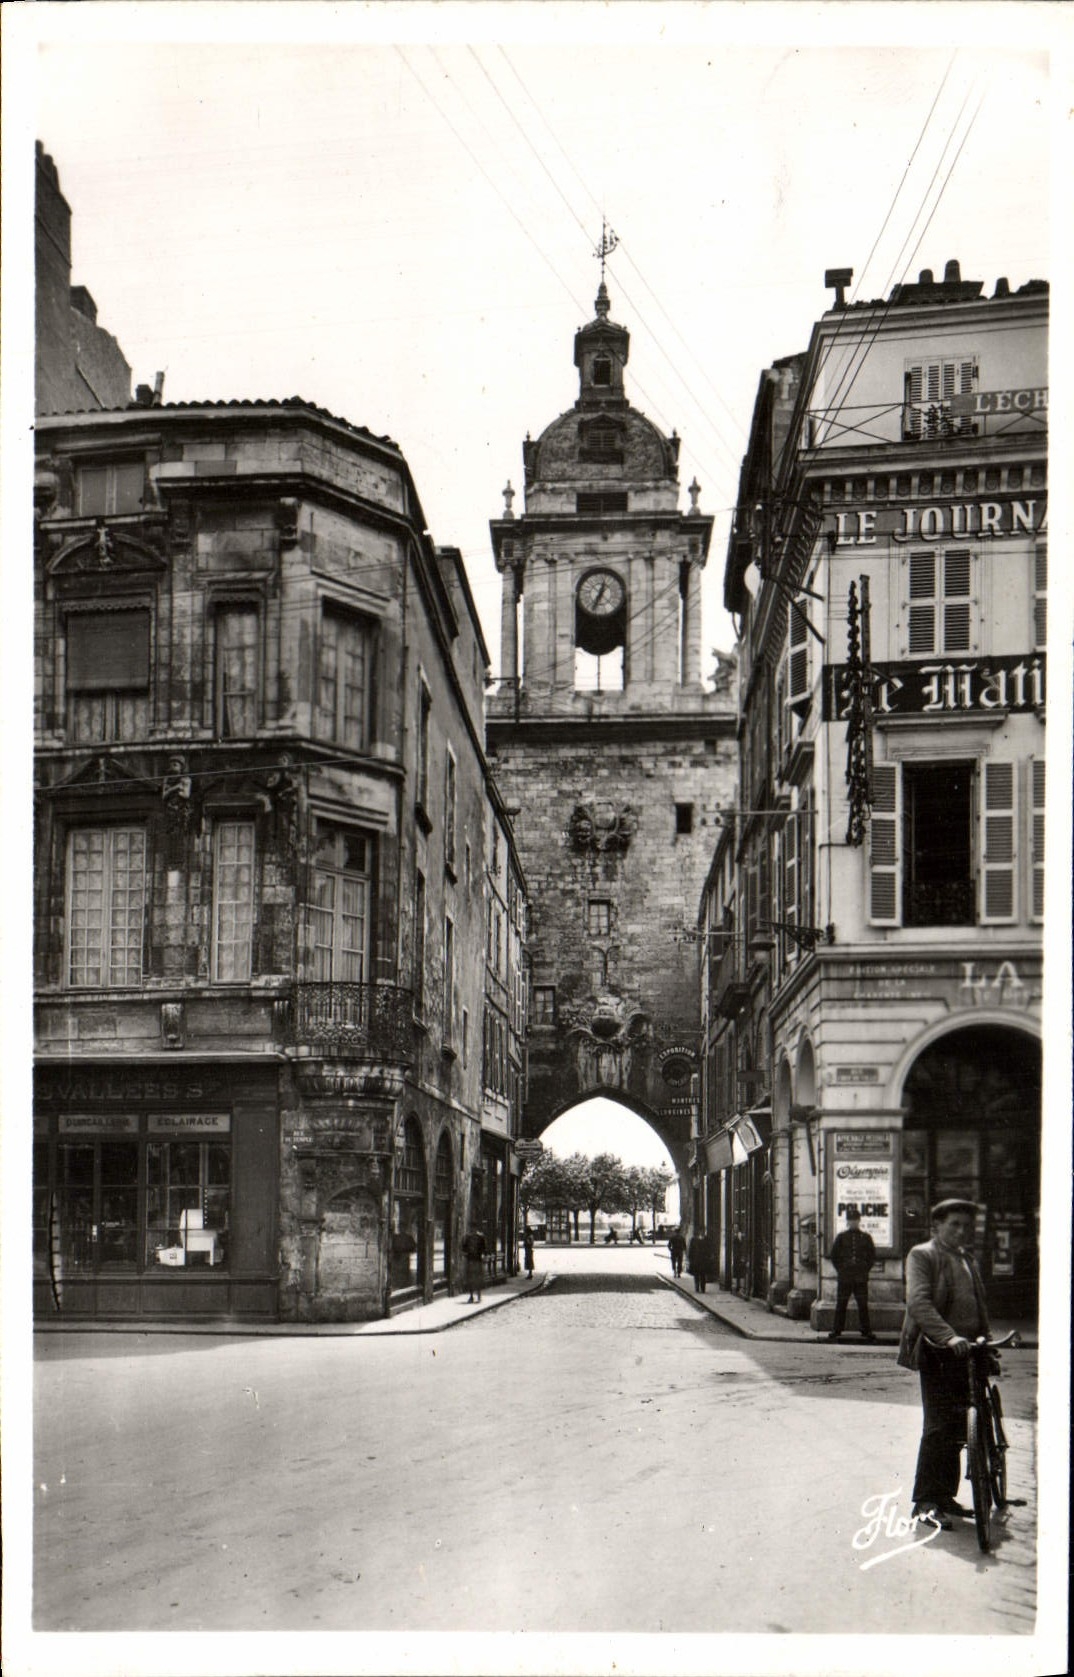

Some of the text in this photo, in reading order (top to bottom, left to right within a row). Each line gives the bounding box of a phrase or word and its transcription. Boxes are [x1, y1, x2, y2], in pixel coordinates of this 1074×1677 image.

[835, 511, 878, 545] LE
[961, 961, 1024, 988] LA
[659, 1045, 696, 1060] EXPOSITION
